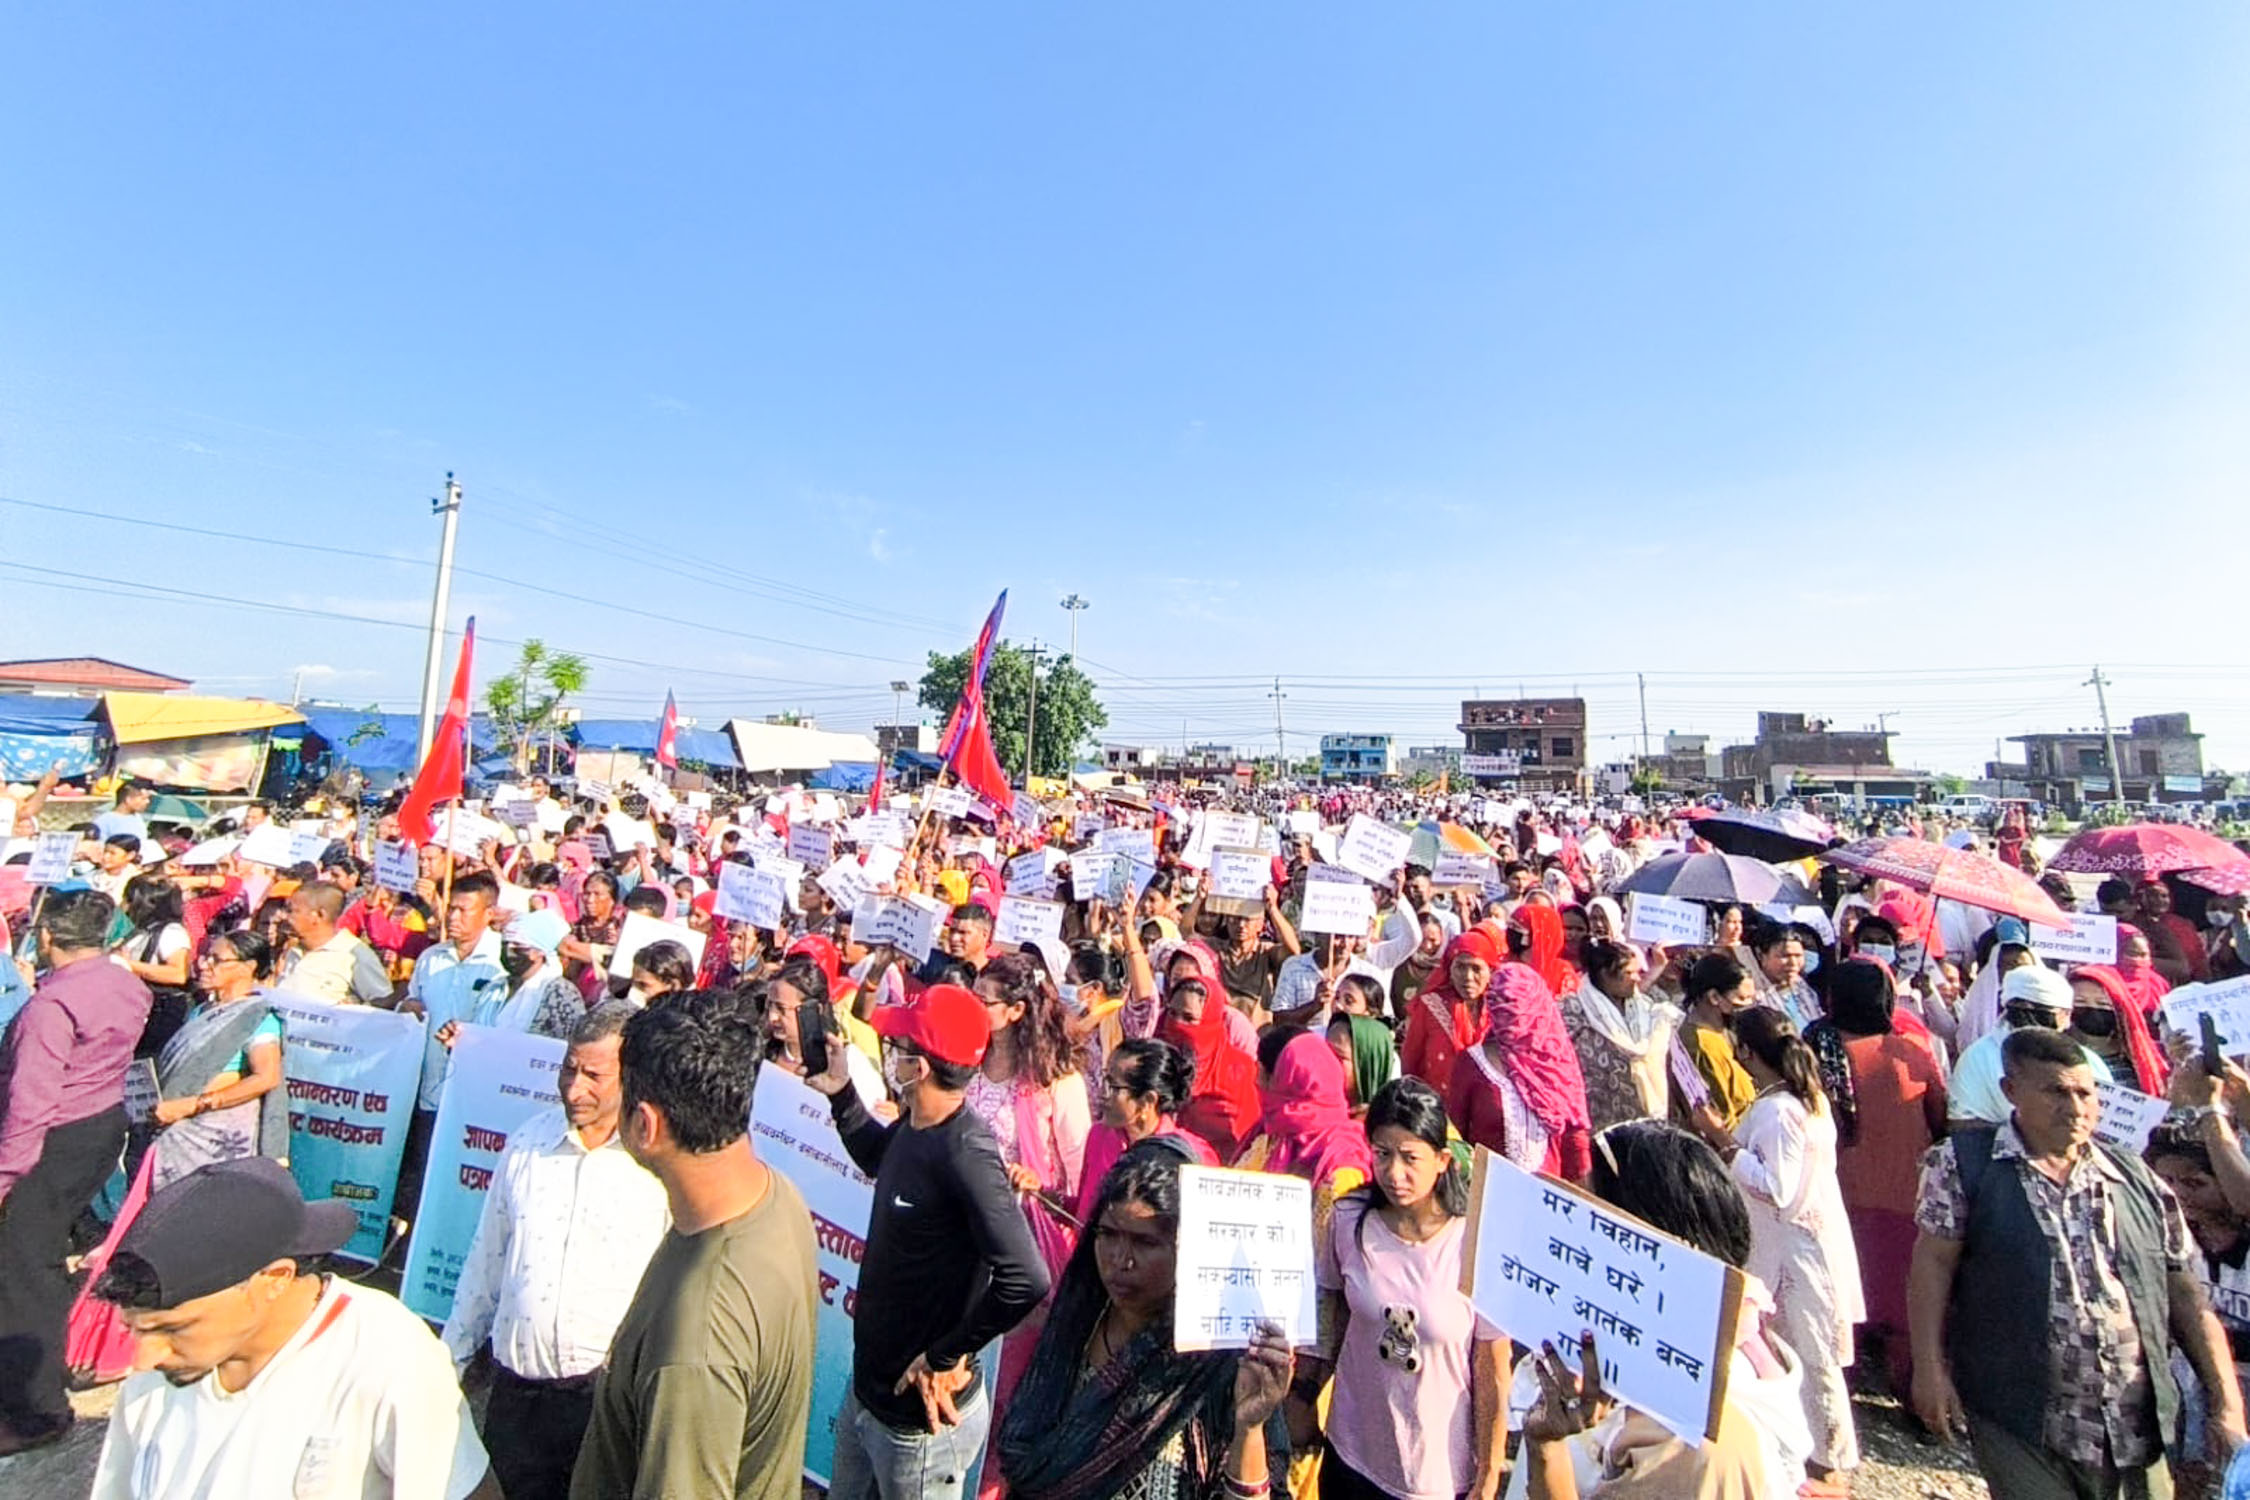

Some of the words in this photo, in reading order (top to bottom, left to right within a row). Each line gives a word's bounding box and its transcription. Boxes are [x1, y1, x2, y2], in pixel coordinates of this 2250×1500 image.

[1209, 1221, 1258, 1240] सरकार
[1606, 1265, 1644, 1304] घरे
[1501, 1253, 1560, 1305] डोजर
[1573, 1295, 1643, 1347] आतंक
[1656, 1339, 1704, 1382] बन्द
